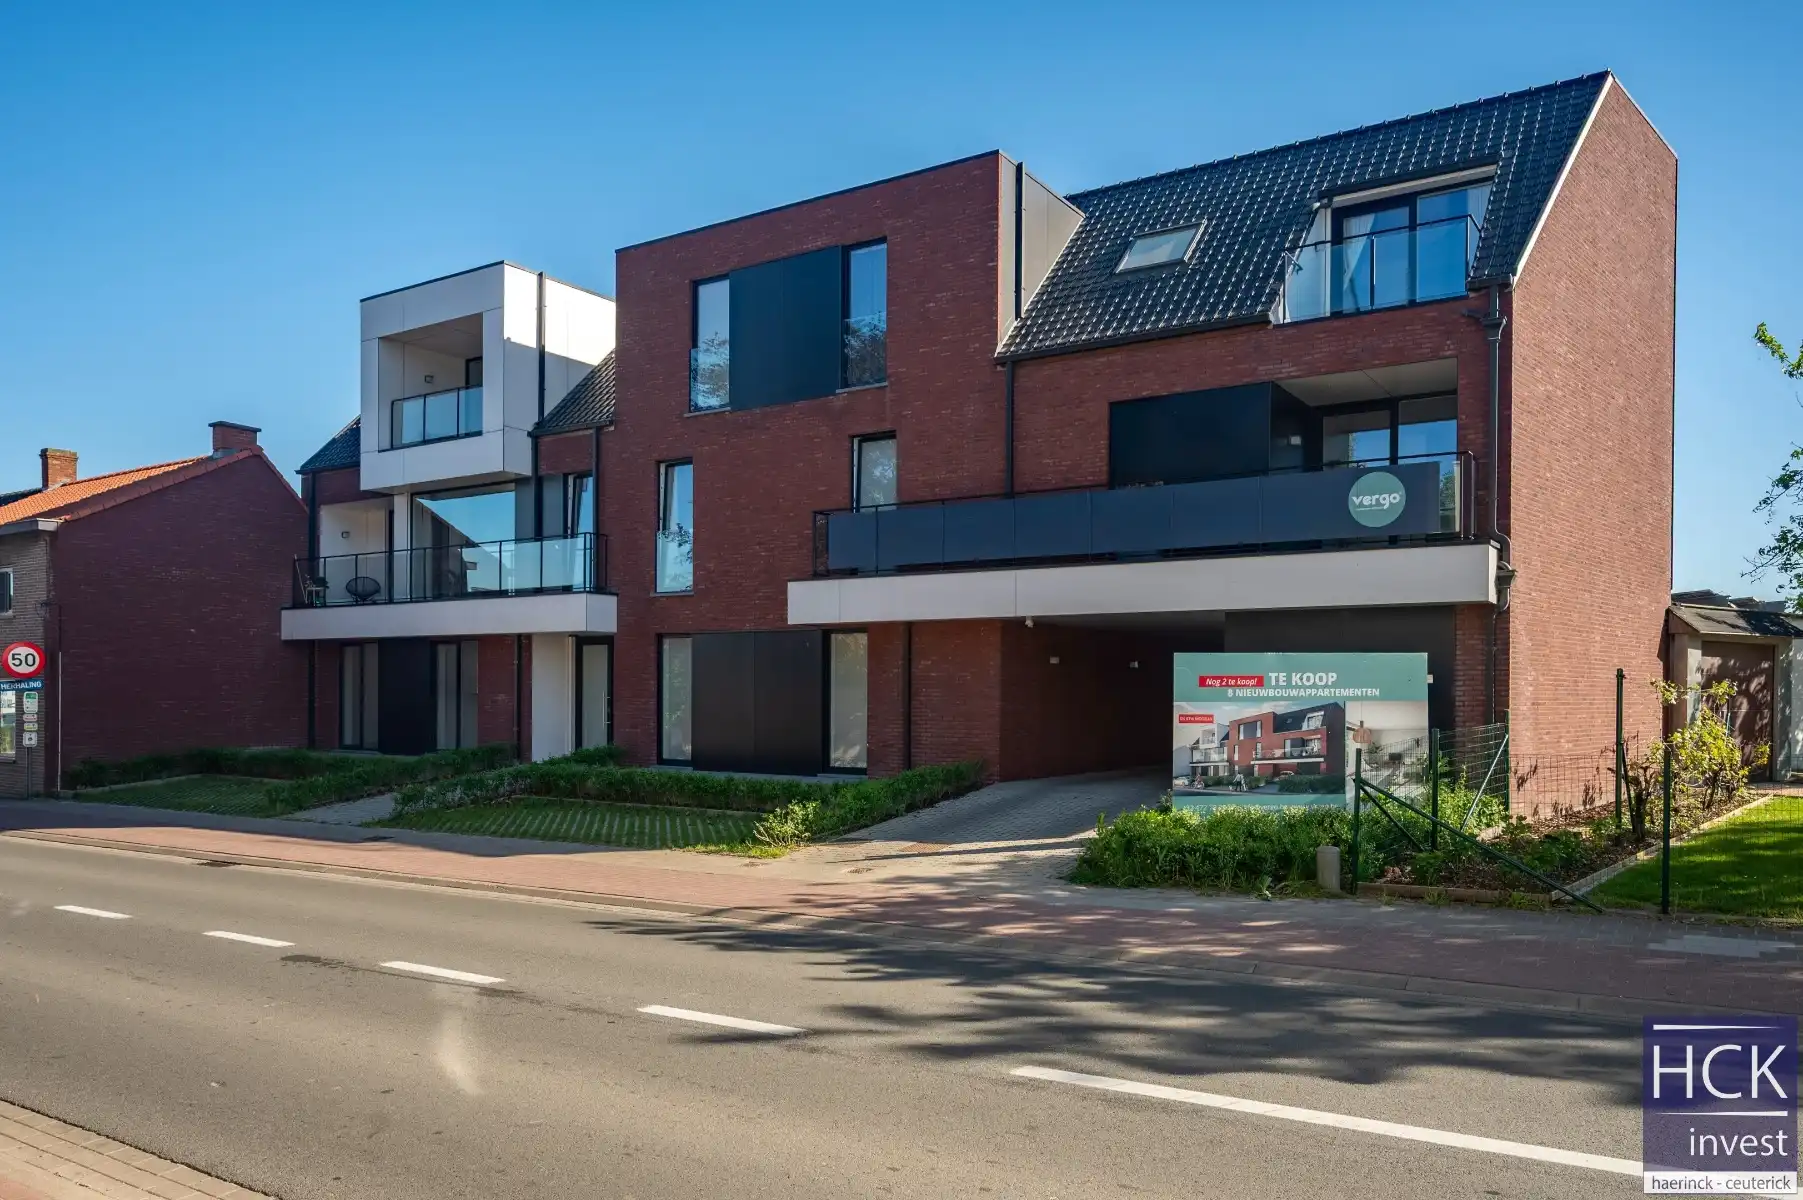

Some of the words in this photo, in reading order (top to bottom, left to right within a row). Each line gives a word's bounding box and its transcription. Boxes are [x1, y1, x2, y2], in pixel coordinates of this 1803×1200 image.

[1351, 493, 1400, 510] vergo
[11, 653, 36, 667] 50
[1206, 678, 1221, 687] Nog
[1228, 678, 1235, 686] te
[1237, 678, 1257, 687] koop!
[1269, 672, 1287, 686] TE
[1291, 672, 1337, 686] KOOP
[1, 681, 42, 690] HERHALING
[1227, 689, 1233, 697] 8
[1235, 688, 1380, 697] NIEUWBOUWAPPARTEMENTEN
